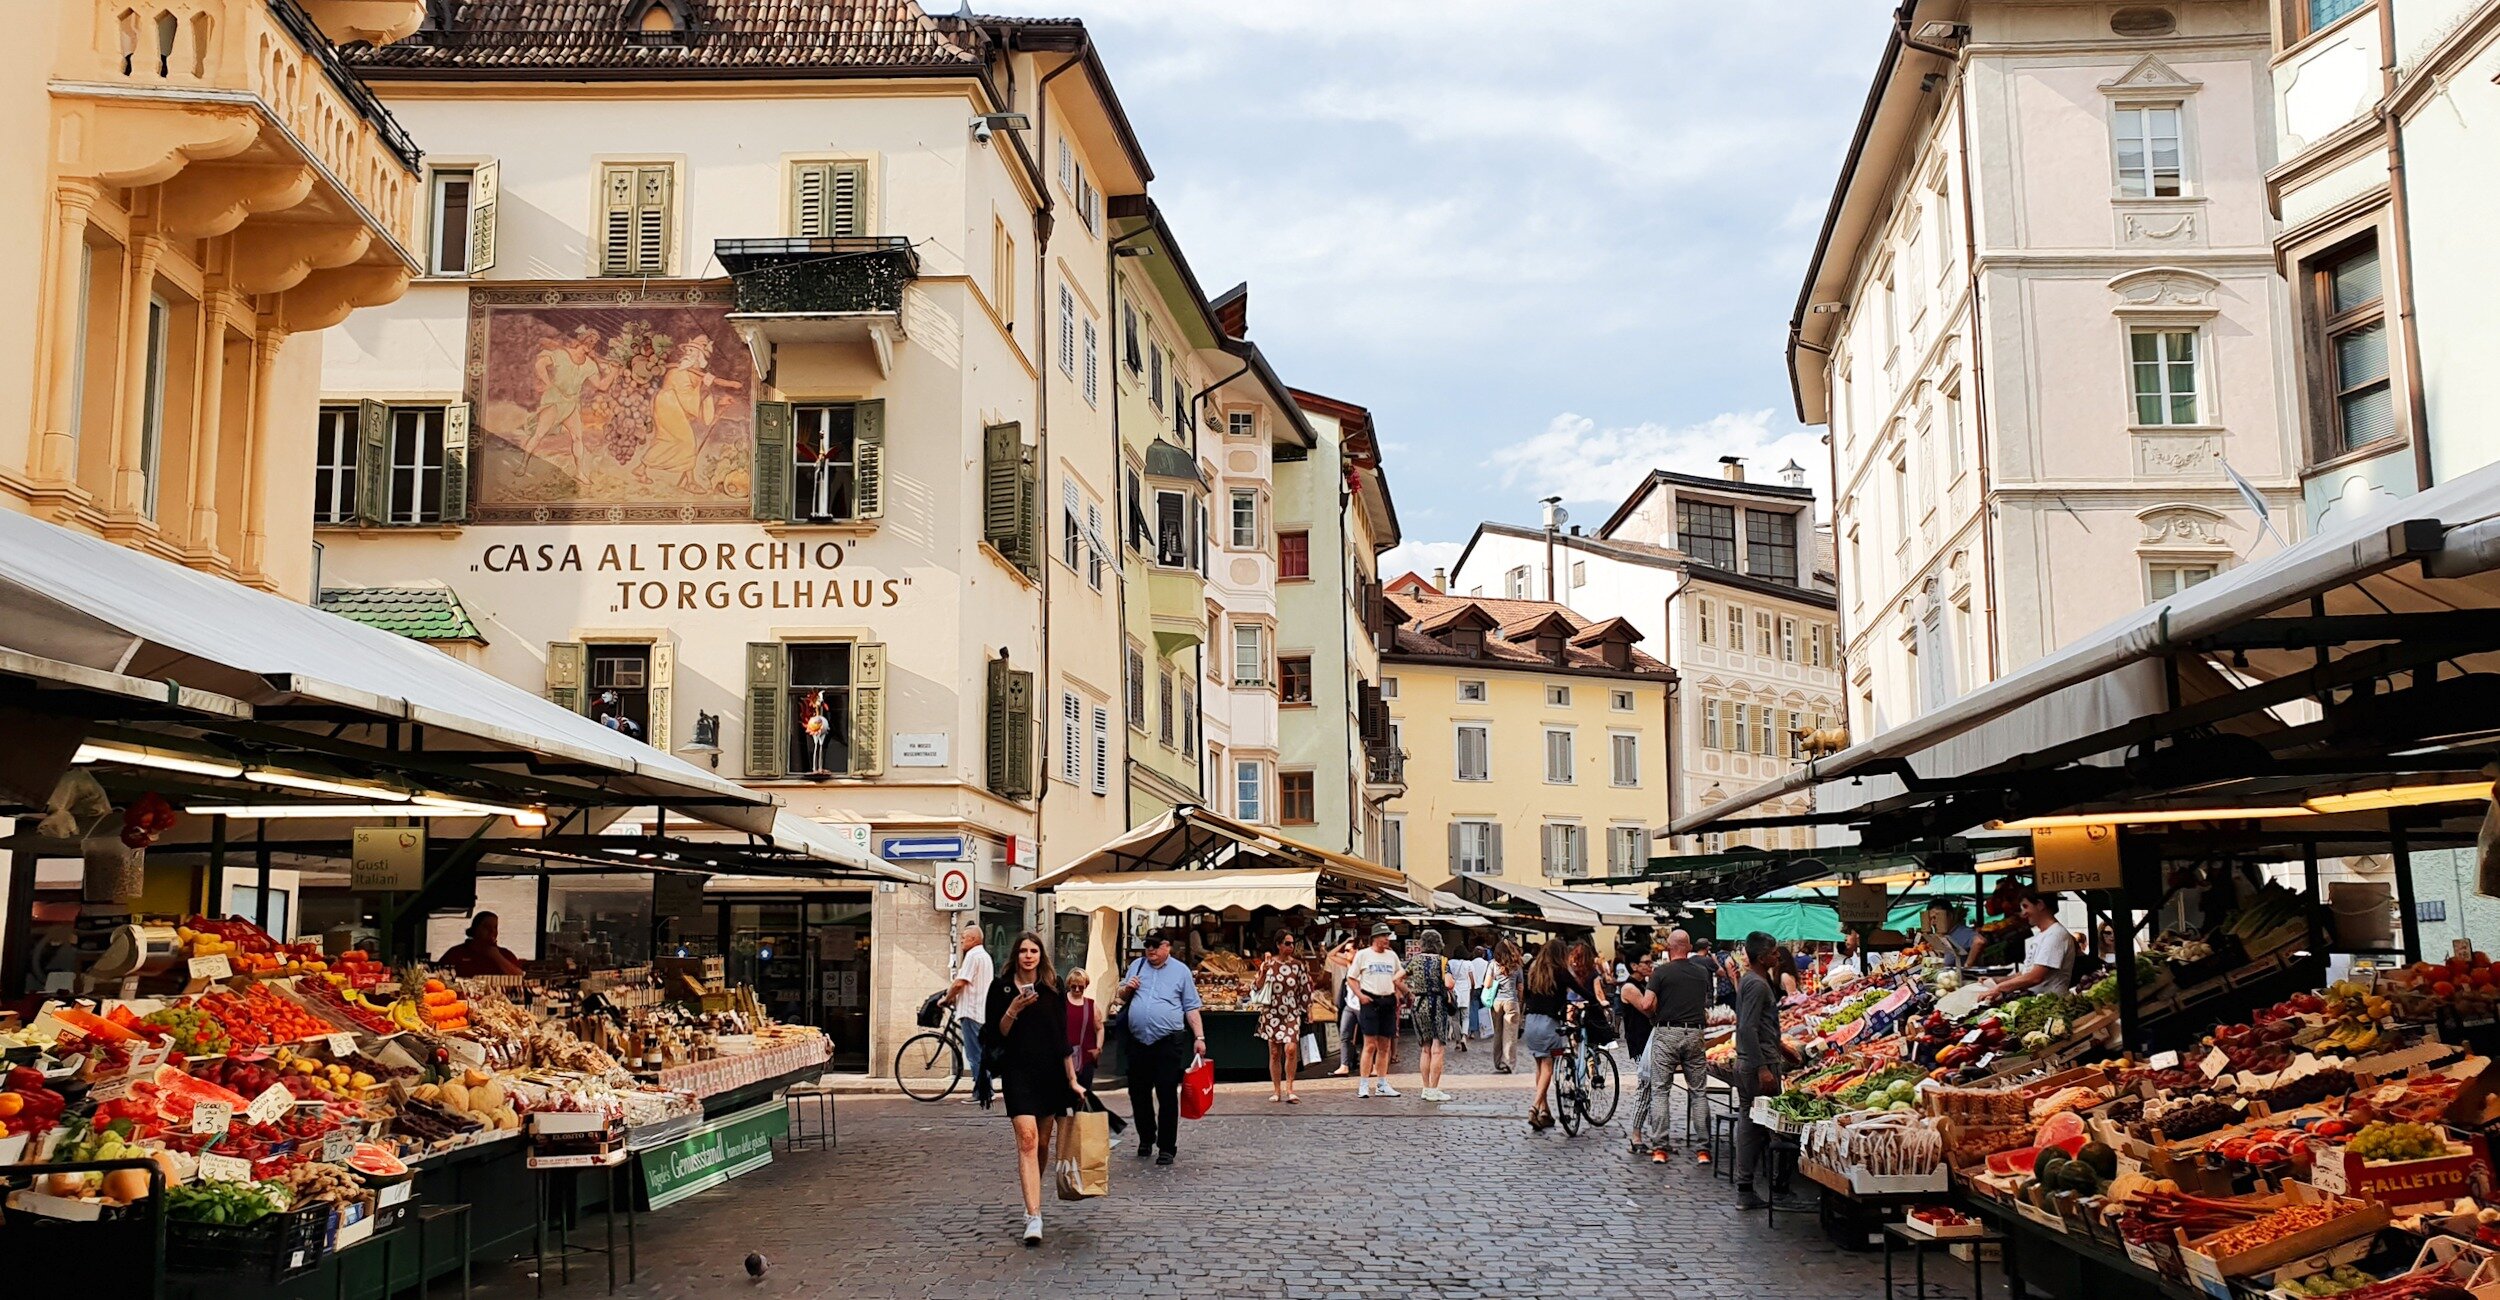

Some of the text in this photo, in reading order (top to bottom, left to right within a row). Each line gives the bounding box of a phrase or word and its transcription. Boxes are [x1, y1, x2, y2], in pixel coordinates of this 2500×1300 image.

[597, 543, 646, 571] AL
[2037, 826, 2052, 836] 44
[356, 859, 389, 871] Gusti
[355, 872, 399, 886] Italiani
[2068, 870, 2101, 883] Fava
[265, 1105, 277, 1119] 6
[204, 1116, 215, 1132] 3
[327, 1143, 338, 1159] 8
